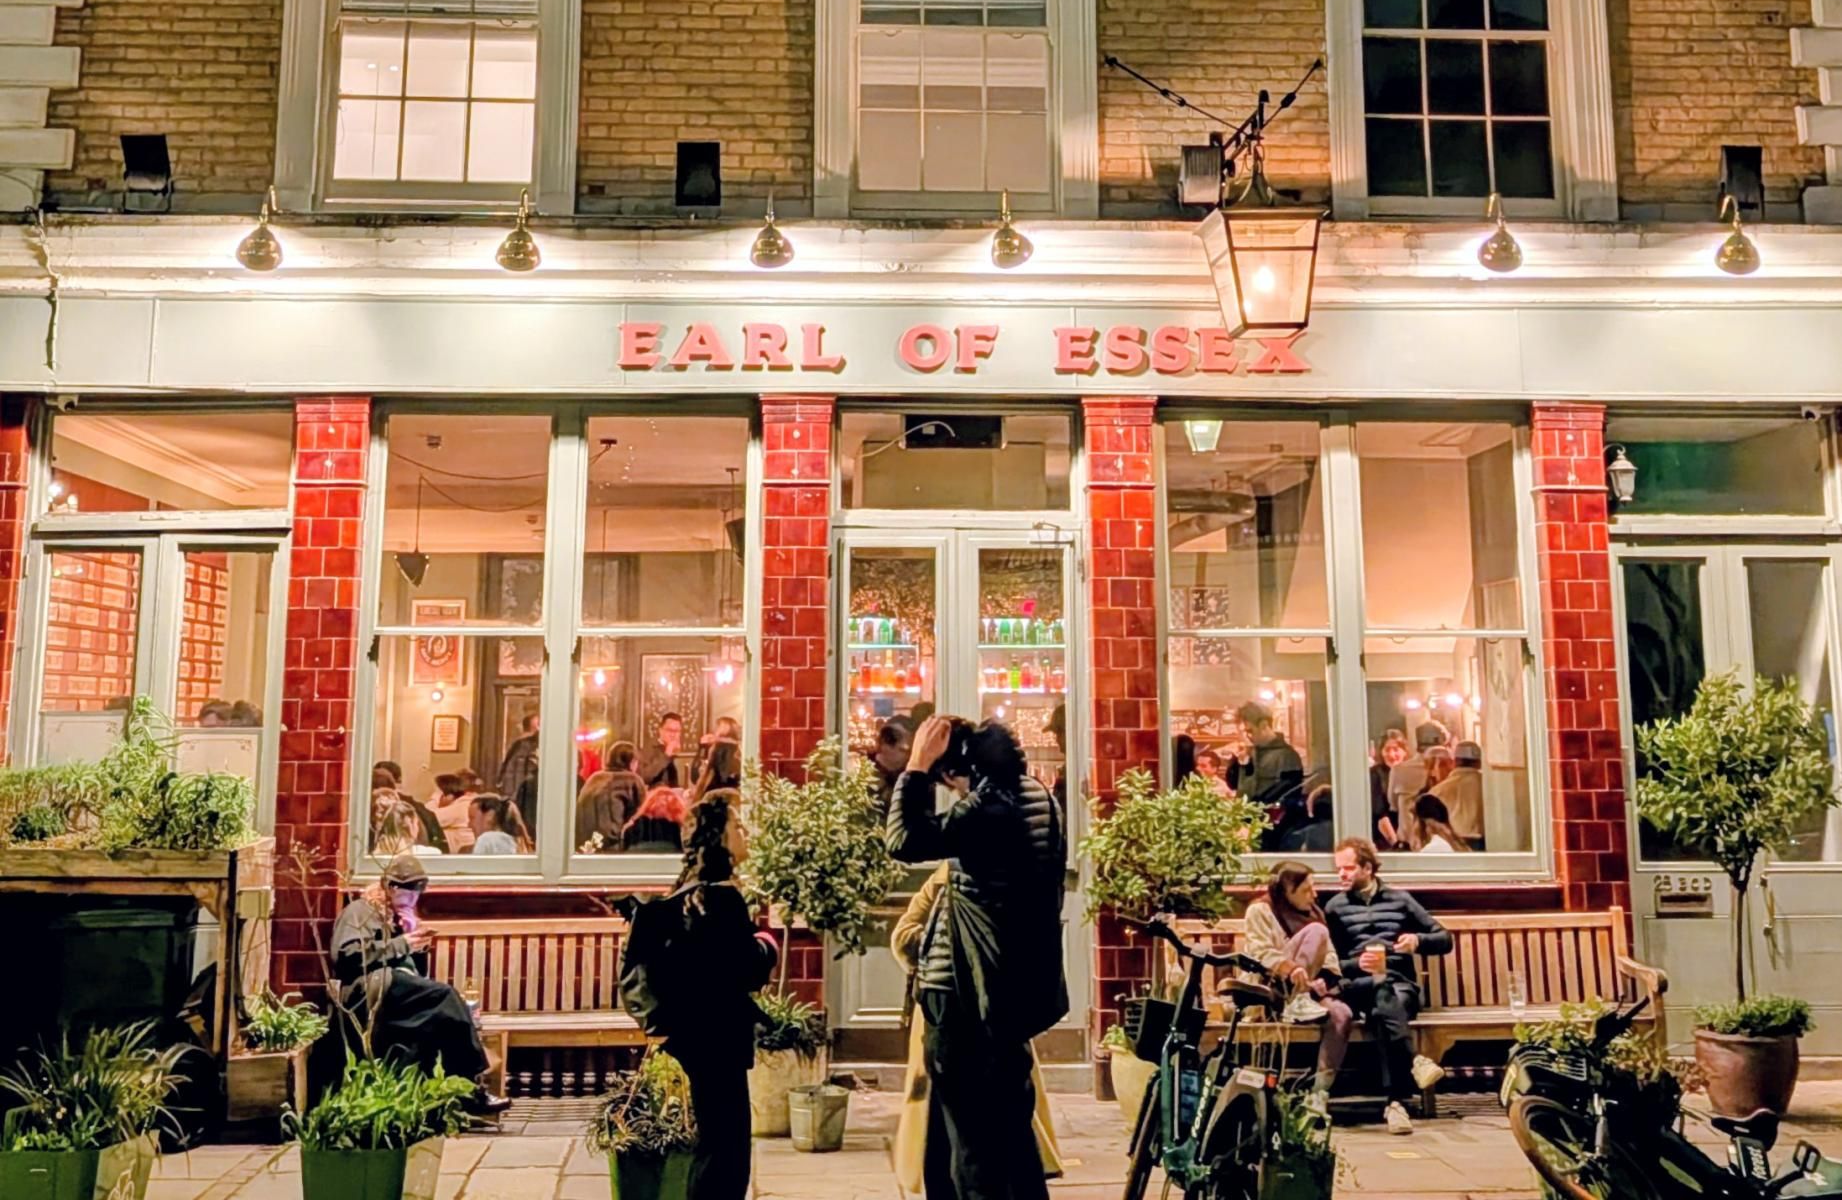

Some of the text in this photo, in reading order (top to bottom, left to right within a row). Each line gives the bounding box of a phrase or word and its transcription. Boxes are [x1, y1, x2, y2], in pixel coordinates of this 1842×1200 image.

[617, 322, 1312, 375] EARL OF ESSEX
